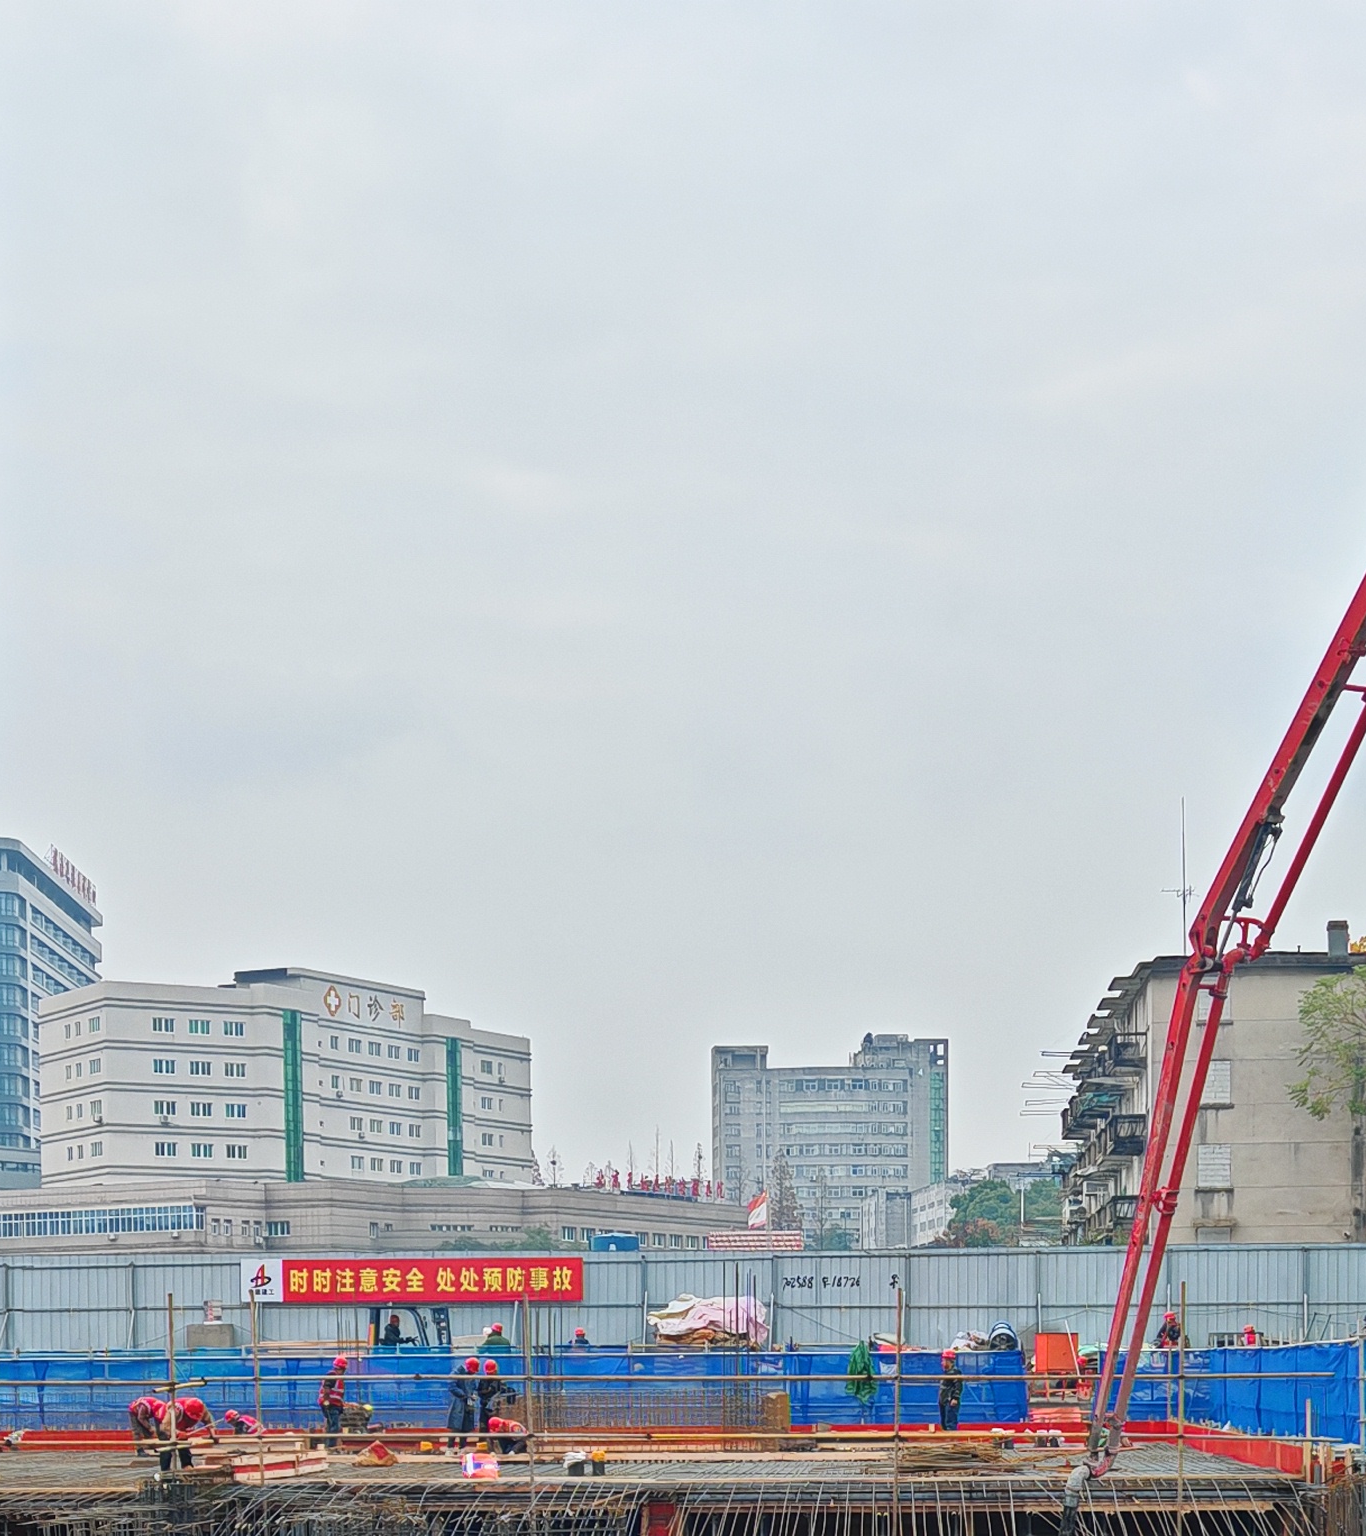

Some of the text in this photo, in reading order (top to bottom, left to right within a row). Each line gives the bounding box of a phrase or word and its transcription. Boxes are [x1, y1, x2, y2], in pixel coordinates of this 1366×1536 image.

[348, 992, 405, 1029] 门诊部
[289, 1266, 573, 1293] 时时注意安全 处处预防事故
